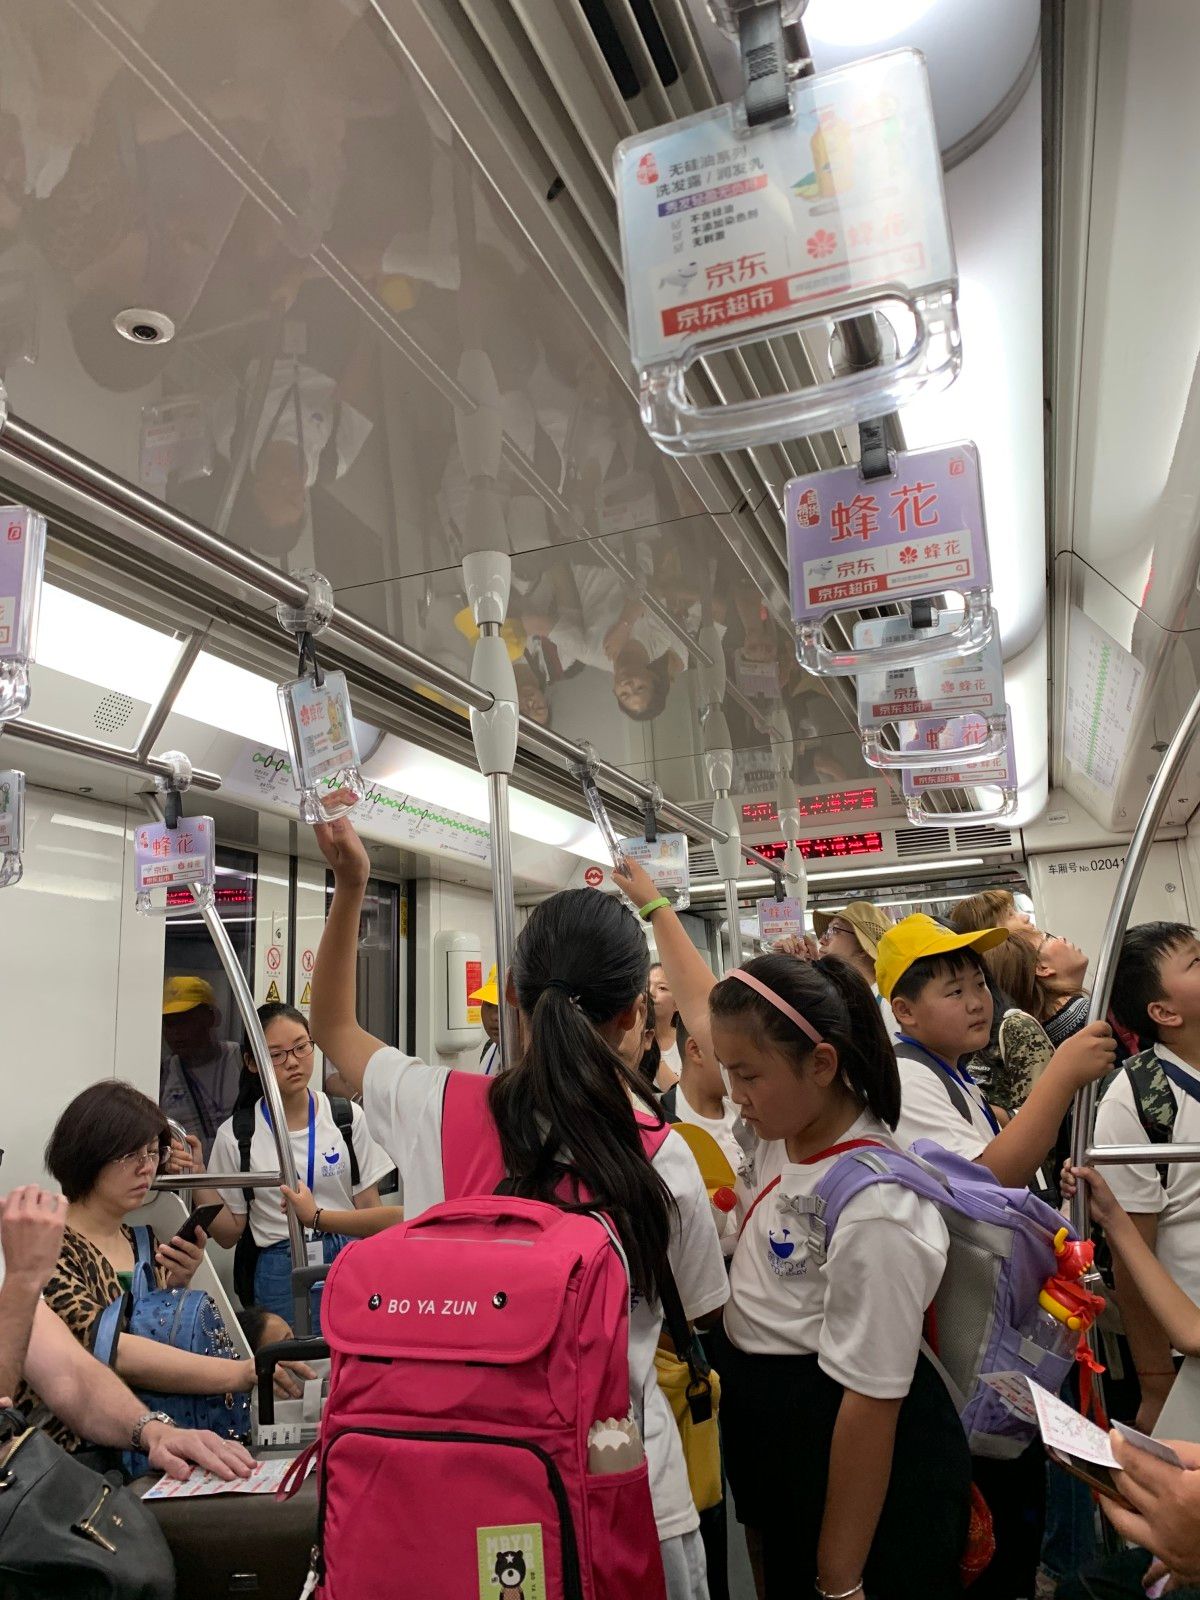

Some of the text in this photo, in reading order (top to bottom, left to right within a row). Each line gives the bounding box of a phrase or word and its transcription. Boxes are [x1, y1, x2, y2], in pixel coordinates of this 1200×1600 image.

[668, 145, 748, 178] 无硅油系列
[705, 252, 768, 290] 京东
[676, 287, 774, 331] 京东超市
[829, 482, 939, 542] 蜂花
[836, 557, 876, 578] 京东
[923, 539, 961, 560] 蜂花
[817, 578, 879, 601] 京东超市
[152, 833, 194, 857] 蜂花
[1047, 861, 1078, 875] 车厢号
[387, 1299, 478, 1315] BO YA ZUN
